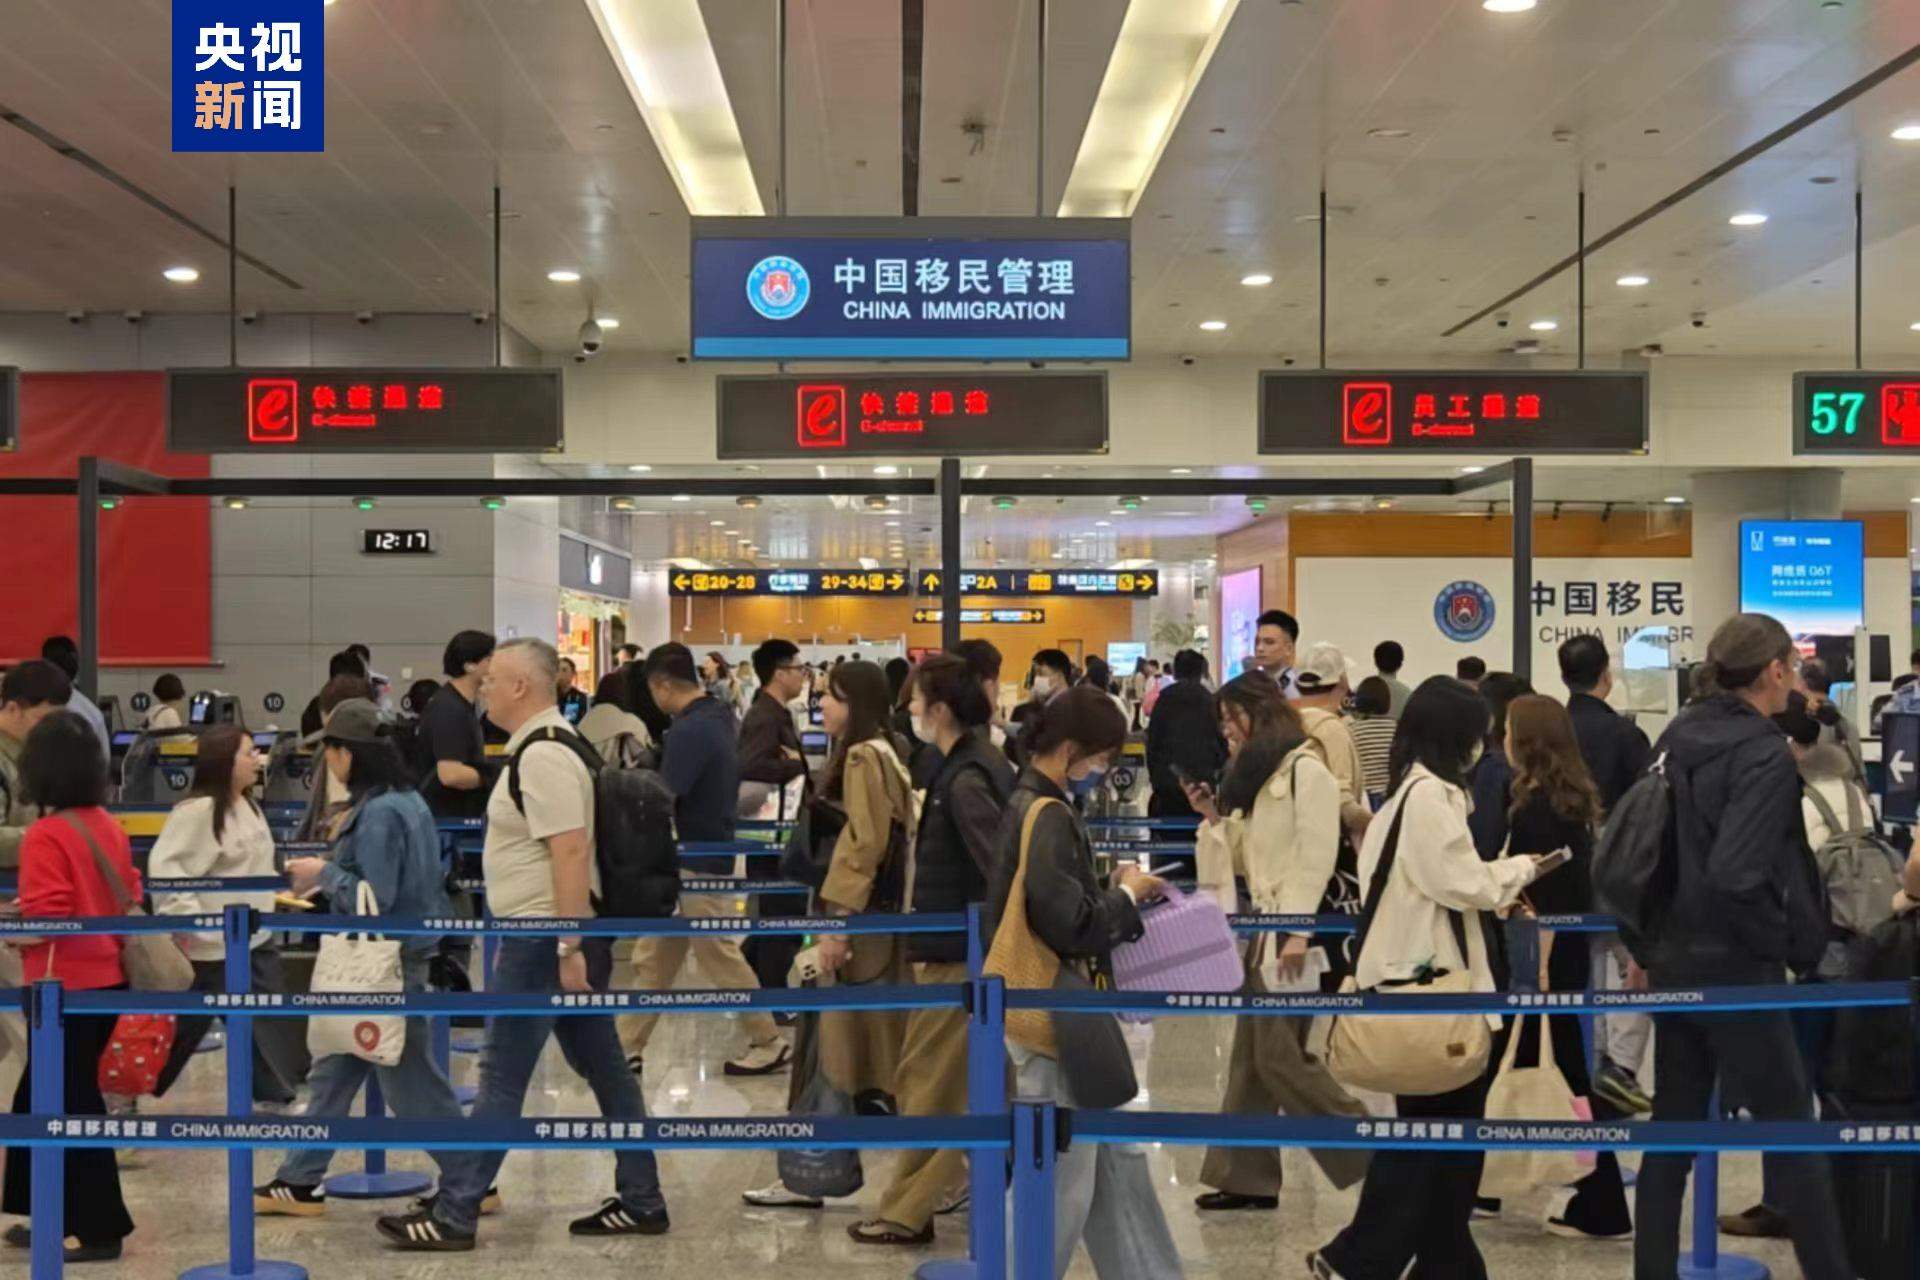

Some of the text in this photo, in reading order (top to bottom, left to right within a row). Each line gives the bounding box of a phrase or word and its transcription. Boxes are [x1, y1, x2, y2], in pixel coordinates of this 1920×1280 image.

[833, 257, 1075, 295] 中国移民管理
[843, 301, 1065, 320] CHINA IMMIGRATION
[1811, 391, 1866, 435] 57
[375, 532, 427, 550] 12:17
[1530, 580, 1685, 617] 中国移民
[267, 696, 281, 708] 10
[171, 774, 186, 787] 10
[292, 994, 328, 1006] CHINA
[329, 994, 406, 1006] IMMIGRATION
[639, 994, 675, 1006] CHINA
[675, 991, 751, 1005] IMMIGRATION
[1252, 995, 1288, 1008] CHINA
[1288, 995, 1364, 1008] IMMIGRATION
[1592, 993, 1630, 1005] CHINA
[1629, 991, 1704, 1004] IMMIGRATION
[47, 1119, 329, 1140] 中国移民管理 CHINA IMMIGRATION
[535, 1121, 814, 1138] 中国移民管理 CHINA IMMIGRATION
[1355, 1120, 1631, 1142] 中国移民管理 CHINA IMMIGRATION
